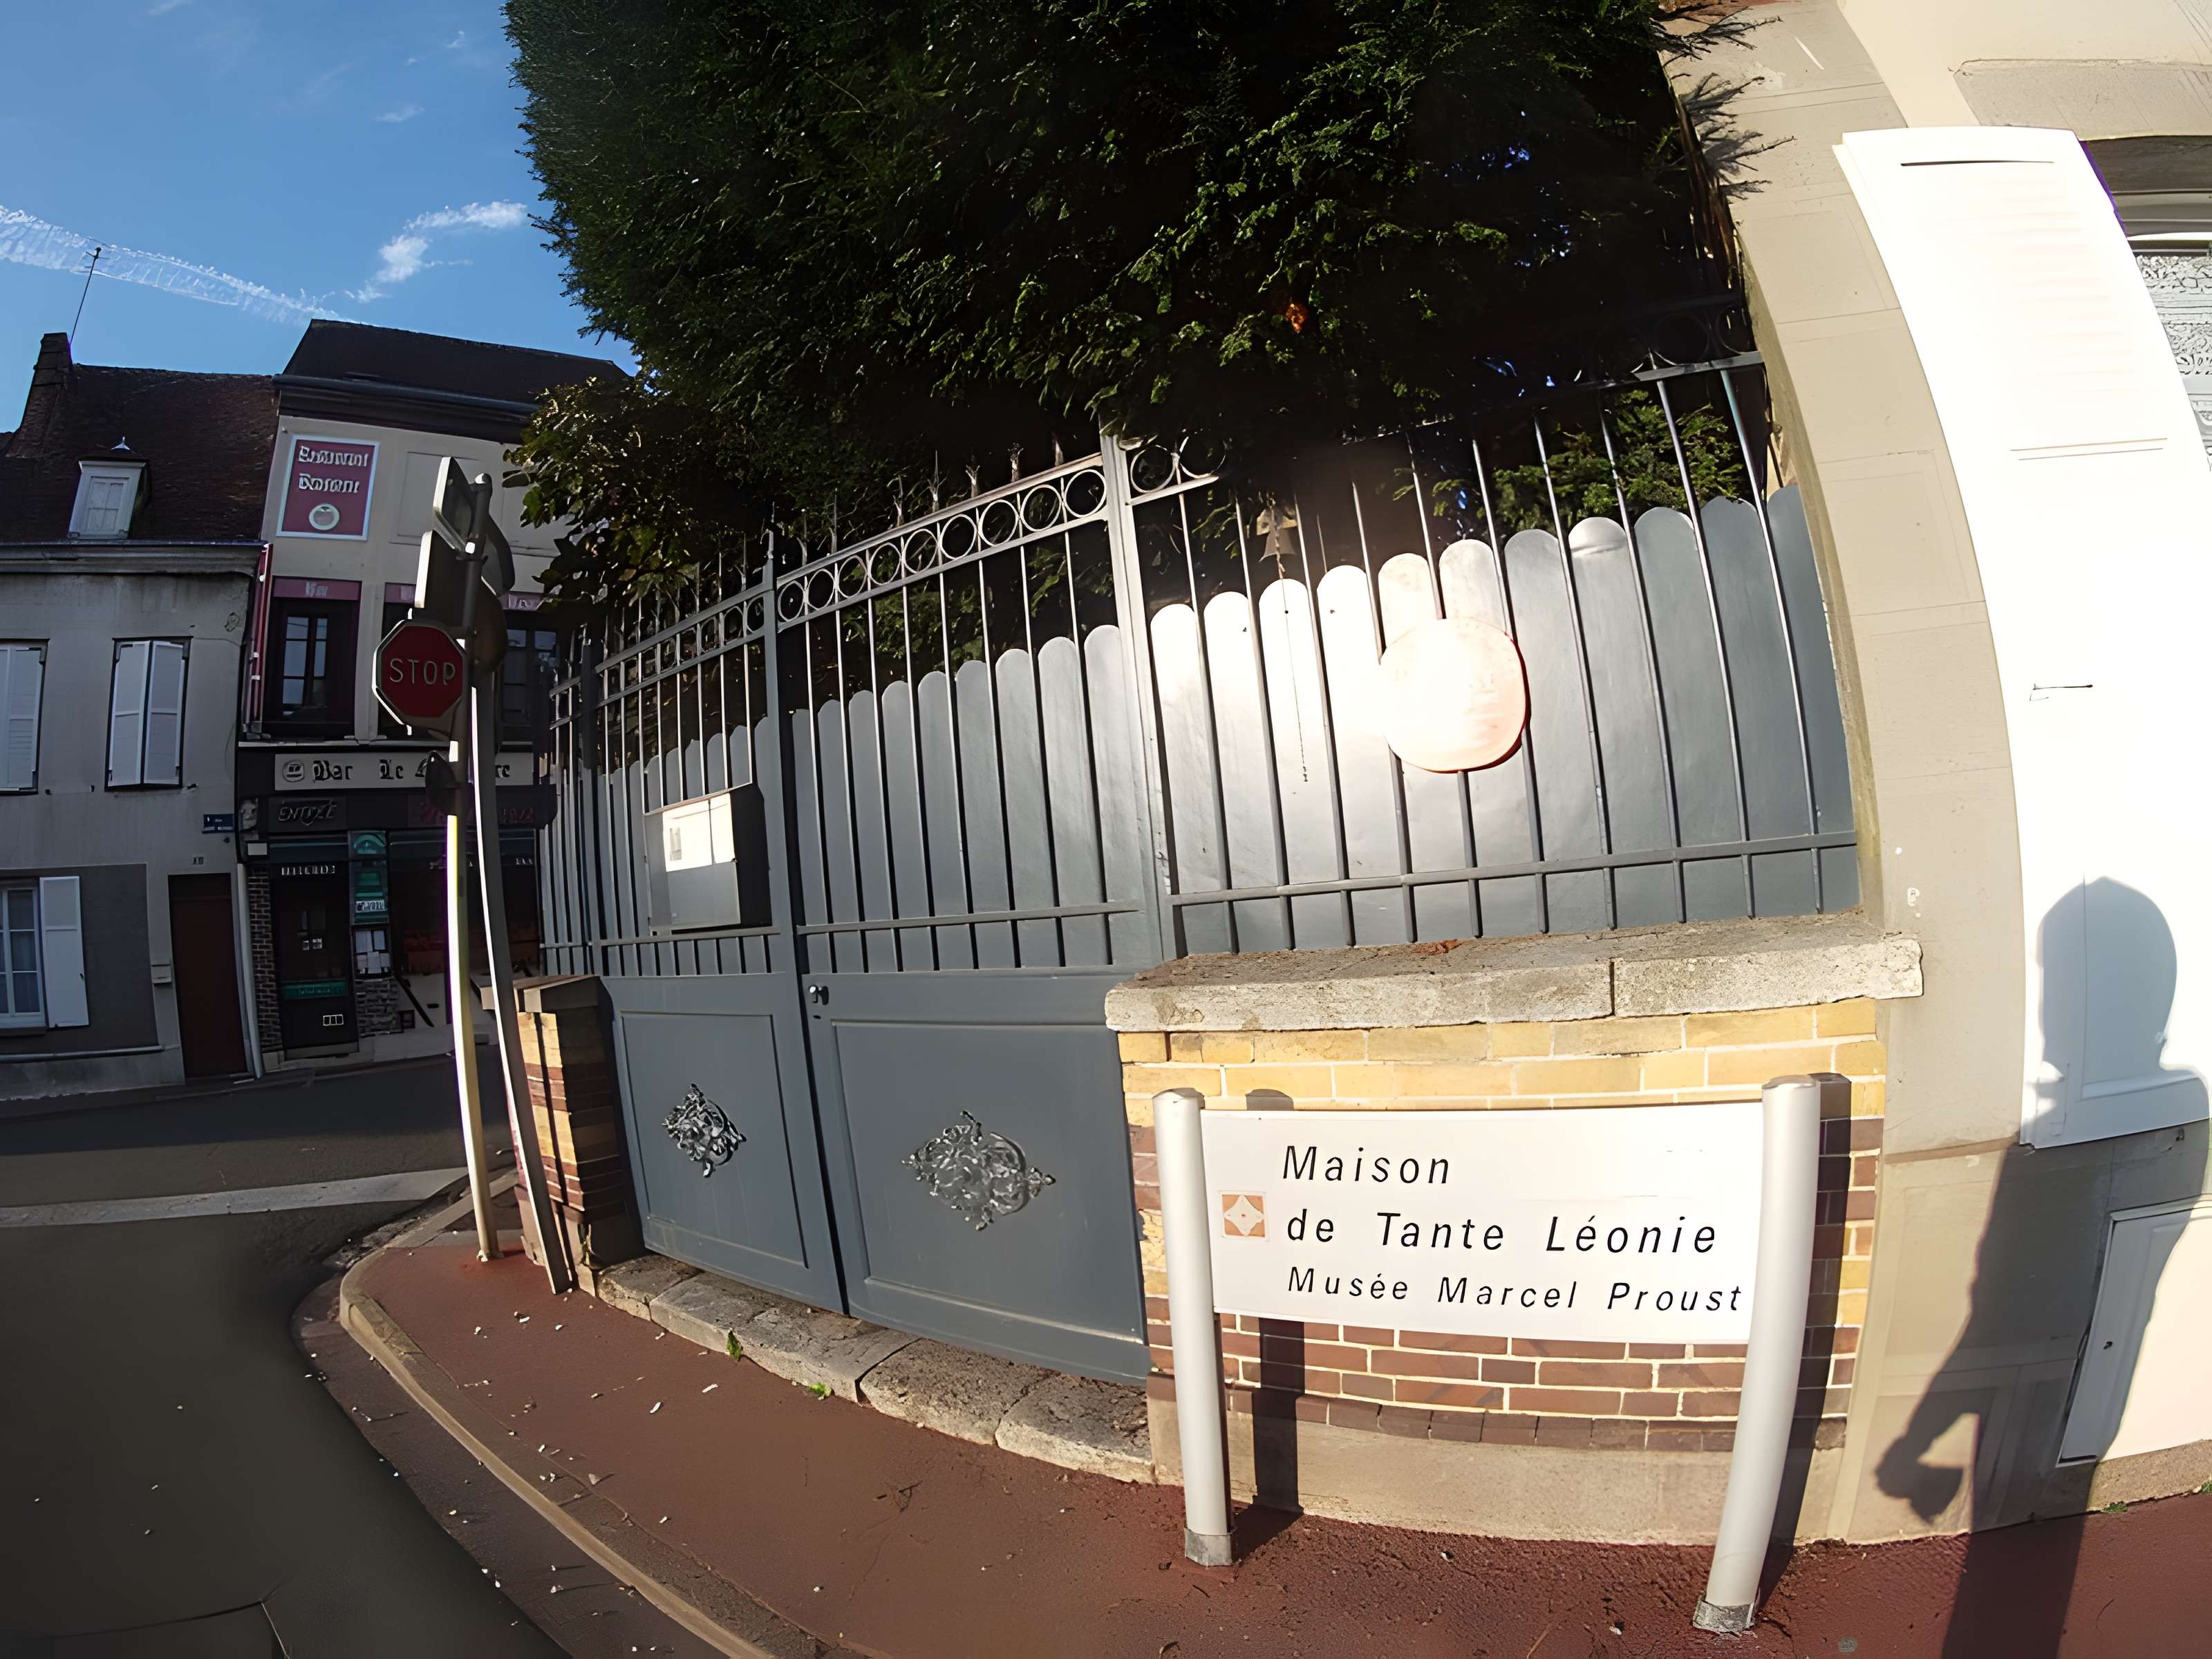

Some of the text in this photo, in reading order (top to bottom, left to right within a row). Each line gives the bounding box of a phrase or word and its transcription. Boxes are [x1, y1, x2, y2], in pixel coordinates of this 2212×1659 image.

[389, 657, 456, 685] STOP
[1282, 1145, 1449, 1184] Maison
[1287, 1208, 1715, 1253] de Tante Léonie
[1288, 1266, 1741, 1311] Musée Marcel Proust
